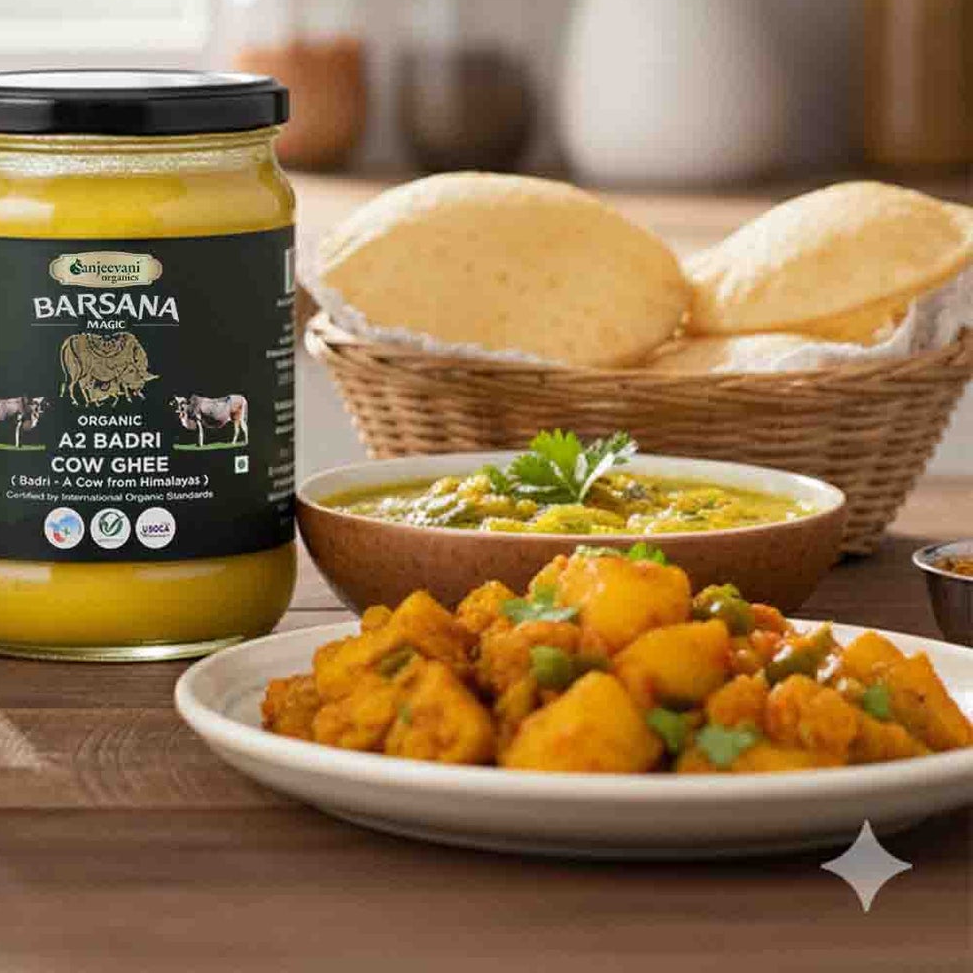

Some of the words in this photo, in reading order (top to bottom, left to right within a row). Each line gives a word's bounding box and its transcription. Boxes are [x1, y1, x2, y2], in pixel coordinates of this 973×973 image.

[70, 259, 140, 277] Sanjeevani
[101, 274, 139, 284] organics
[33, 293, 180, 323] BARSANA
[86, 320, 126, 330] MAGIC
[77, 415, 142, 426] ORGANIC
[58, 432, 86, 449] A2
[94, 432, 161, 449] BADRI
[51, 457, 104, 473] COW
[111, 456, 170, 473] GHEE
[19, 475, 51, 487] Badri
[62, 477, 72, 487] A
[76, 477, 103, 488] Cow
[107, 476, 137, 487] from
[140, 476, 201, 488] Himalayas
[6, 491, 45, 500] Certified
[46, 492, 59, 502] by
[61, 493, 123, 501] International
[125, 493, 164, 503] Organic
[166, 491, 213, 501] Standards
[142, 524, 170, 533] USOCA
